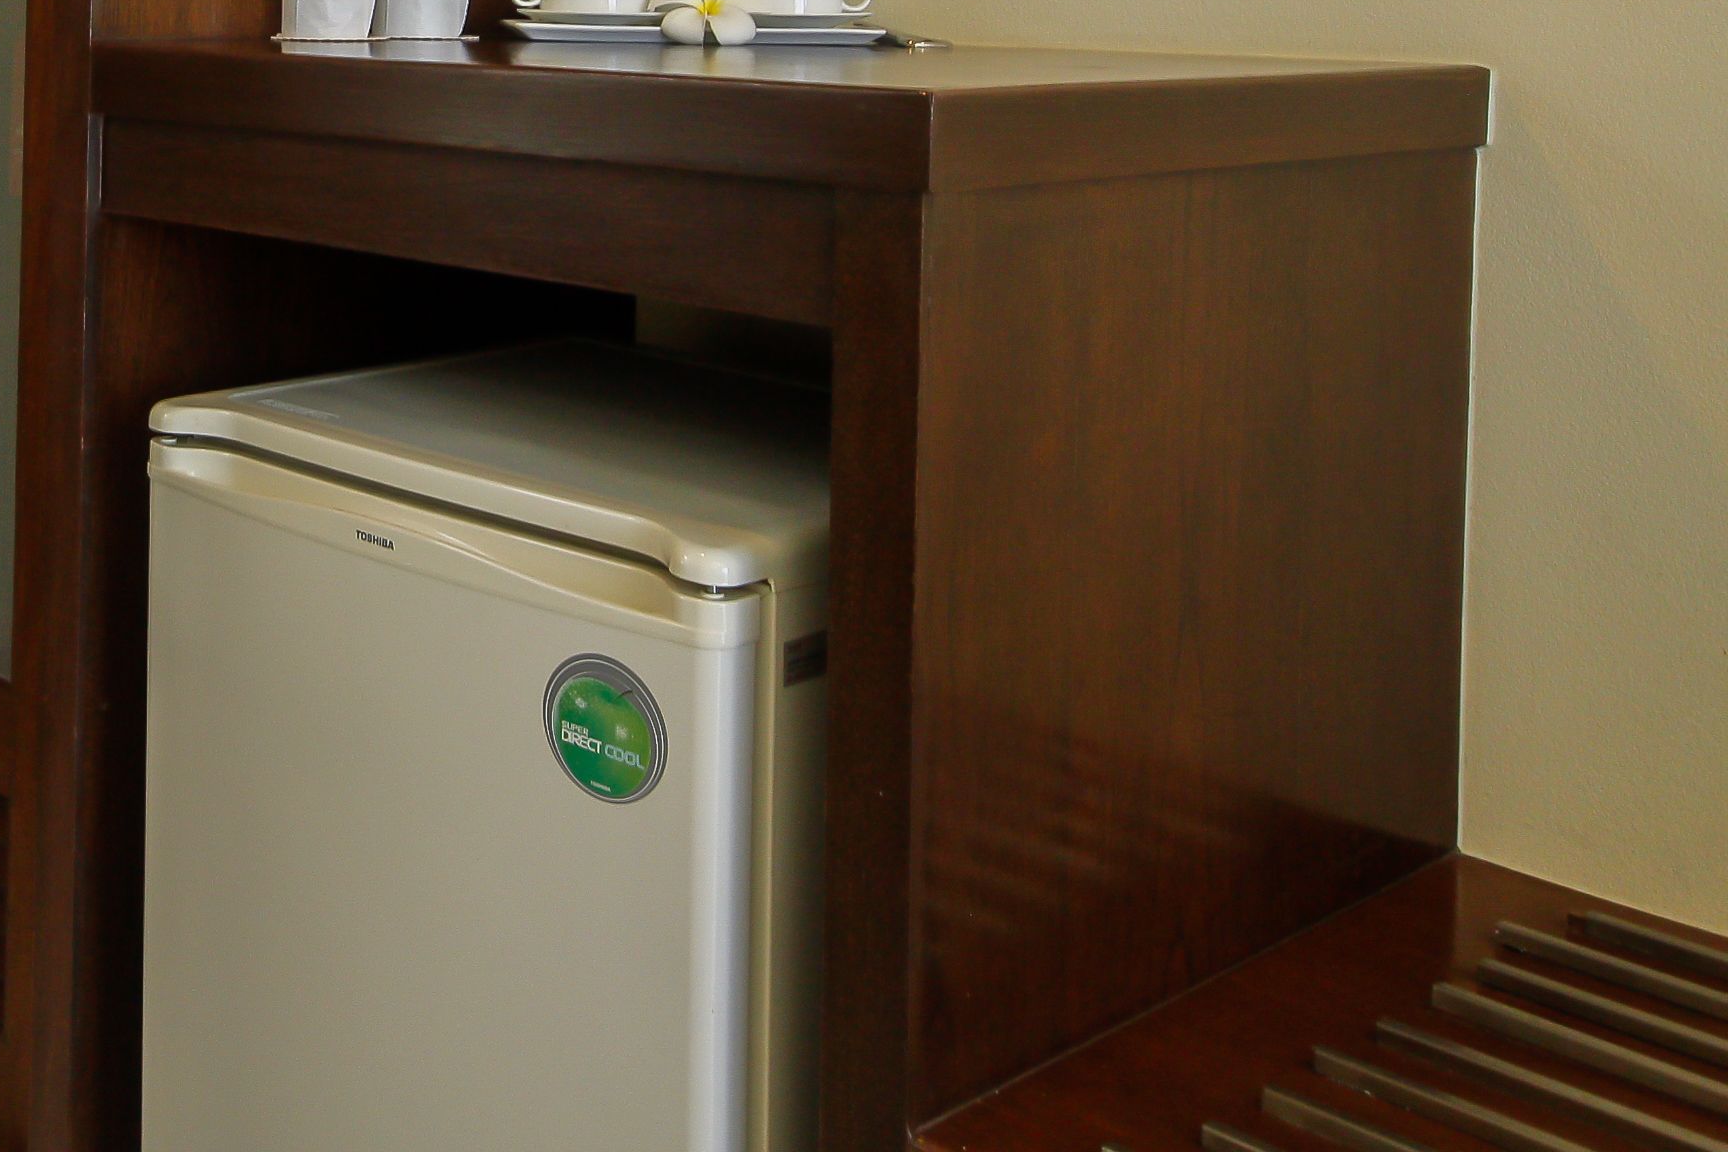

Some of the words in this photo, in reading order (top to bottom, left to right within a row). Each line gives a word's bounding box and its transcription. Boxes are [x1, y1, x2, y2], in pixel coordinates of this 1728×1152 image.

[356, 529, 394, 551] TOSHIBA
[561, 720, 588, 737] SUPER
[561, 728, 602, 754] DIRECT
[605, 744, 645, 770] COOL
